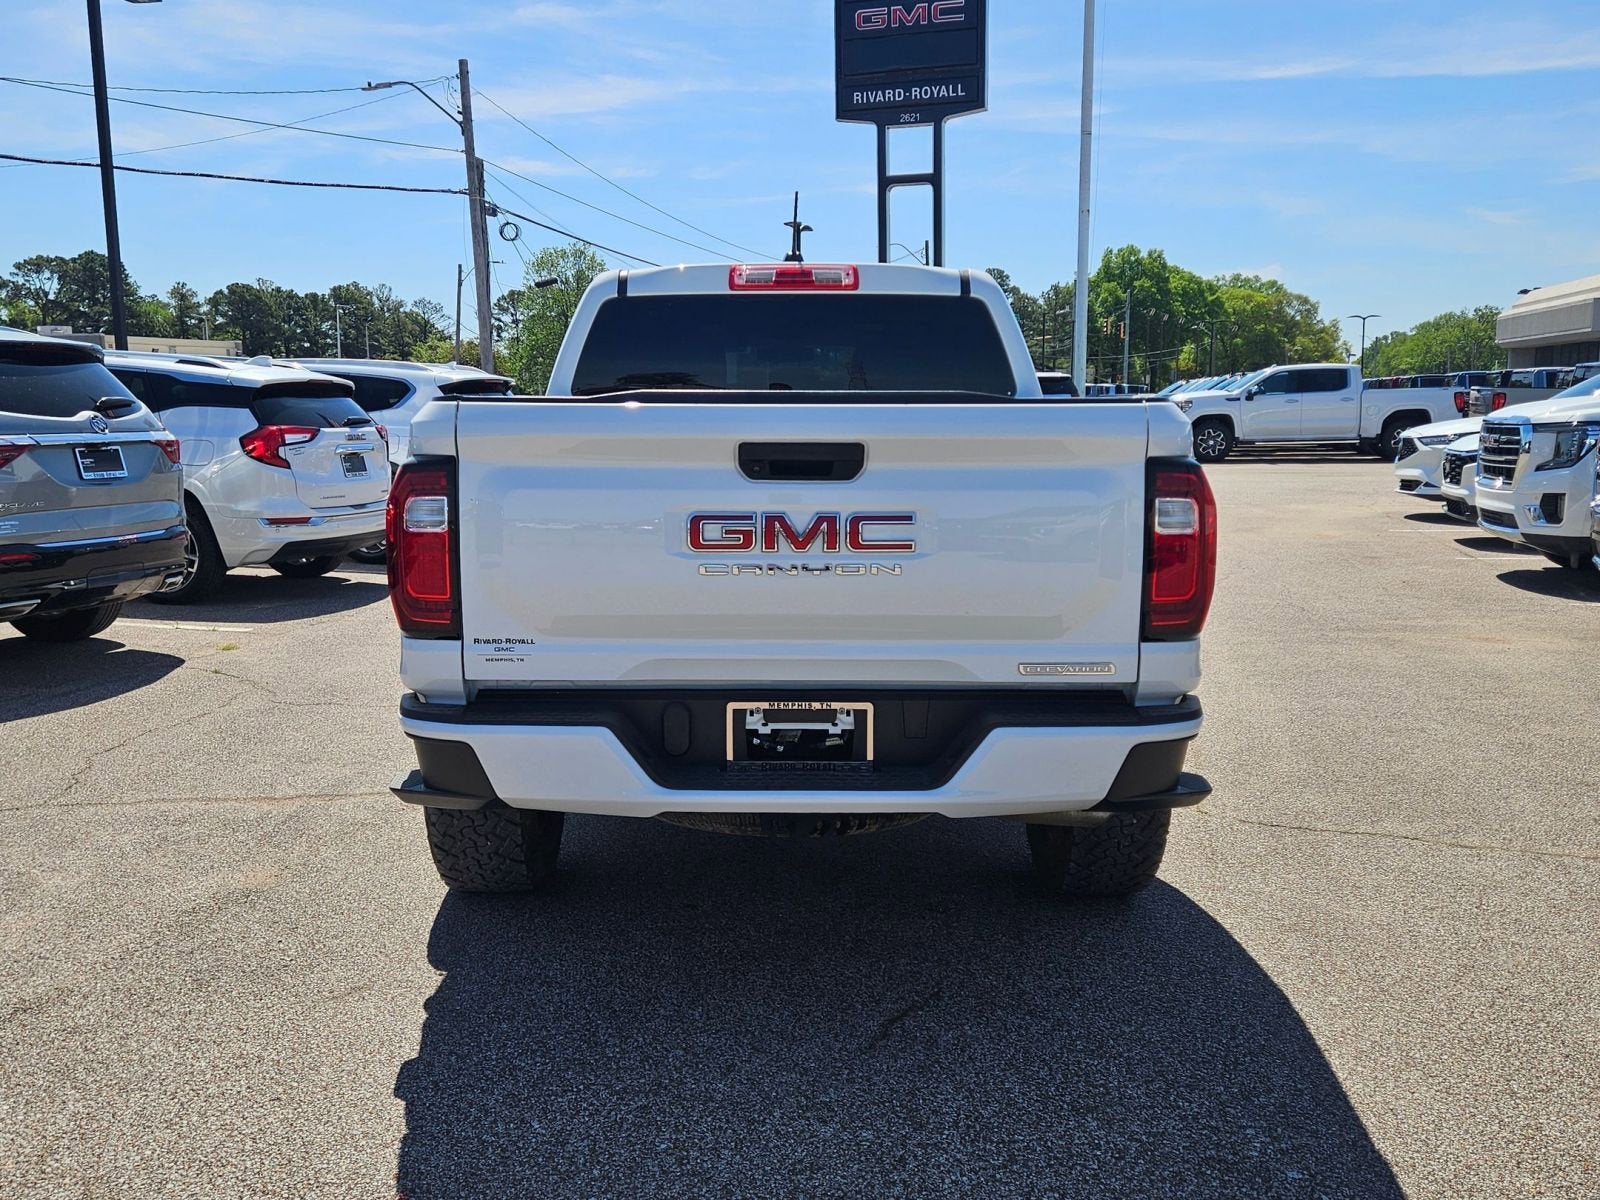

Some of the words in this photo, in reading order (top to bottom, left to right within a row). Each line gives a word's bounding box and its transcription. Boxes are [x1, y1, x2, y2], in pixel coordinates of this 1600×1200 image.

[855, 0, 965, 31] GMC
[853, 84, 966, 104] RIVARD-ROYALL
[900, 113, 920, 123] 2621
[687, 511, 916, 552] GMC
[698, 563, 902, 576] CANYON
[768, 702, 816, 710] MEMPHIS,
